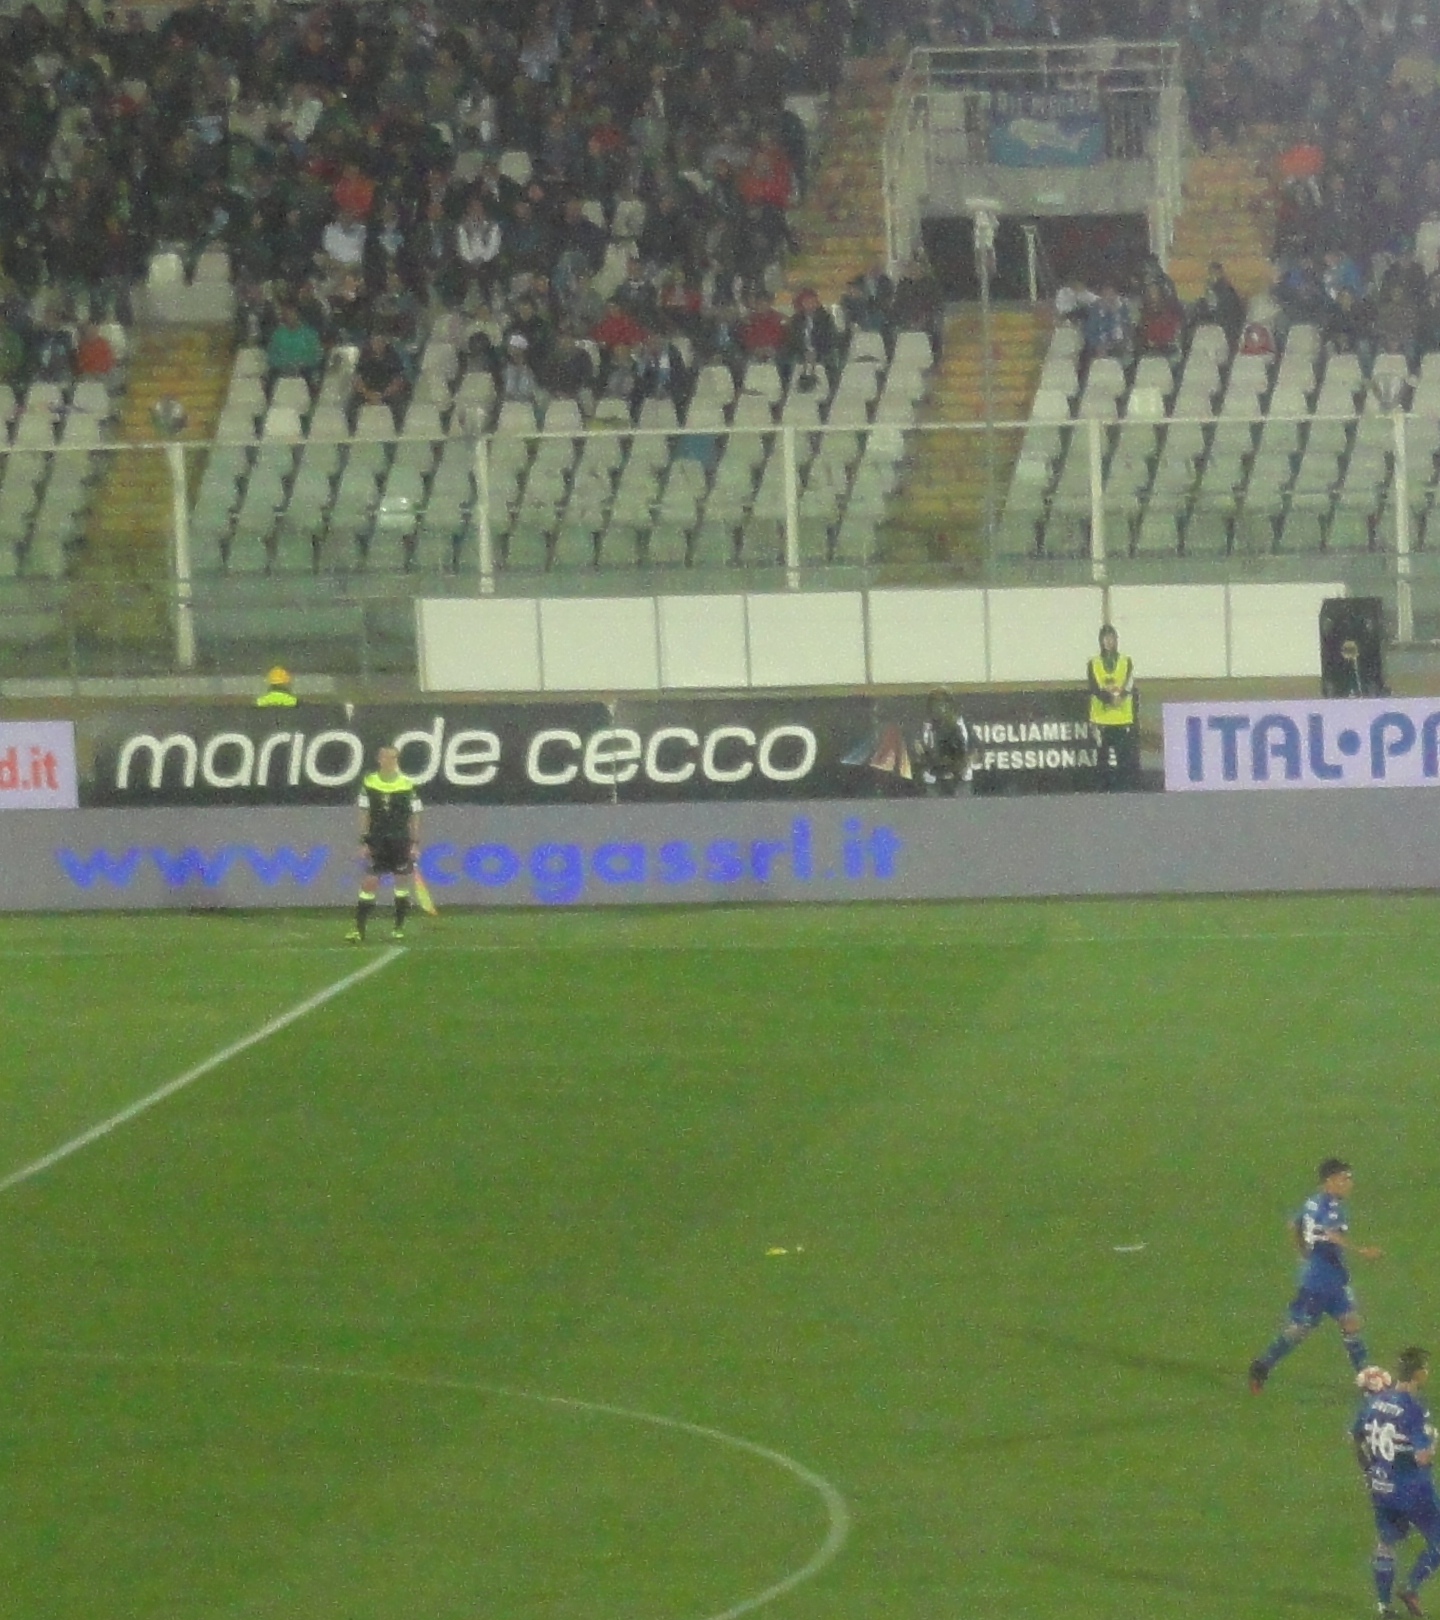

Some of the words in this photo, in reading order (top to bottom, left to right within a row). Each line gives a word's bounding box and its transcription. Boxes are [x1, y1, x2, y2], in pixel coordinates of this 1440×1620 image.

[116, 731, 364, 789] mario
[395, 717, 502, 786] de
[526, 723, 817, 784] cecco
[55, 814, 901, 905] www.cogassrl.it
